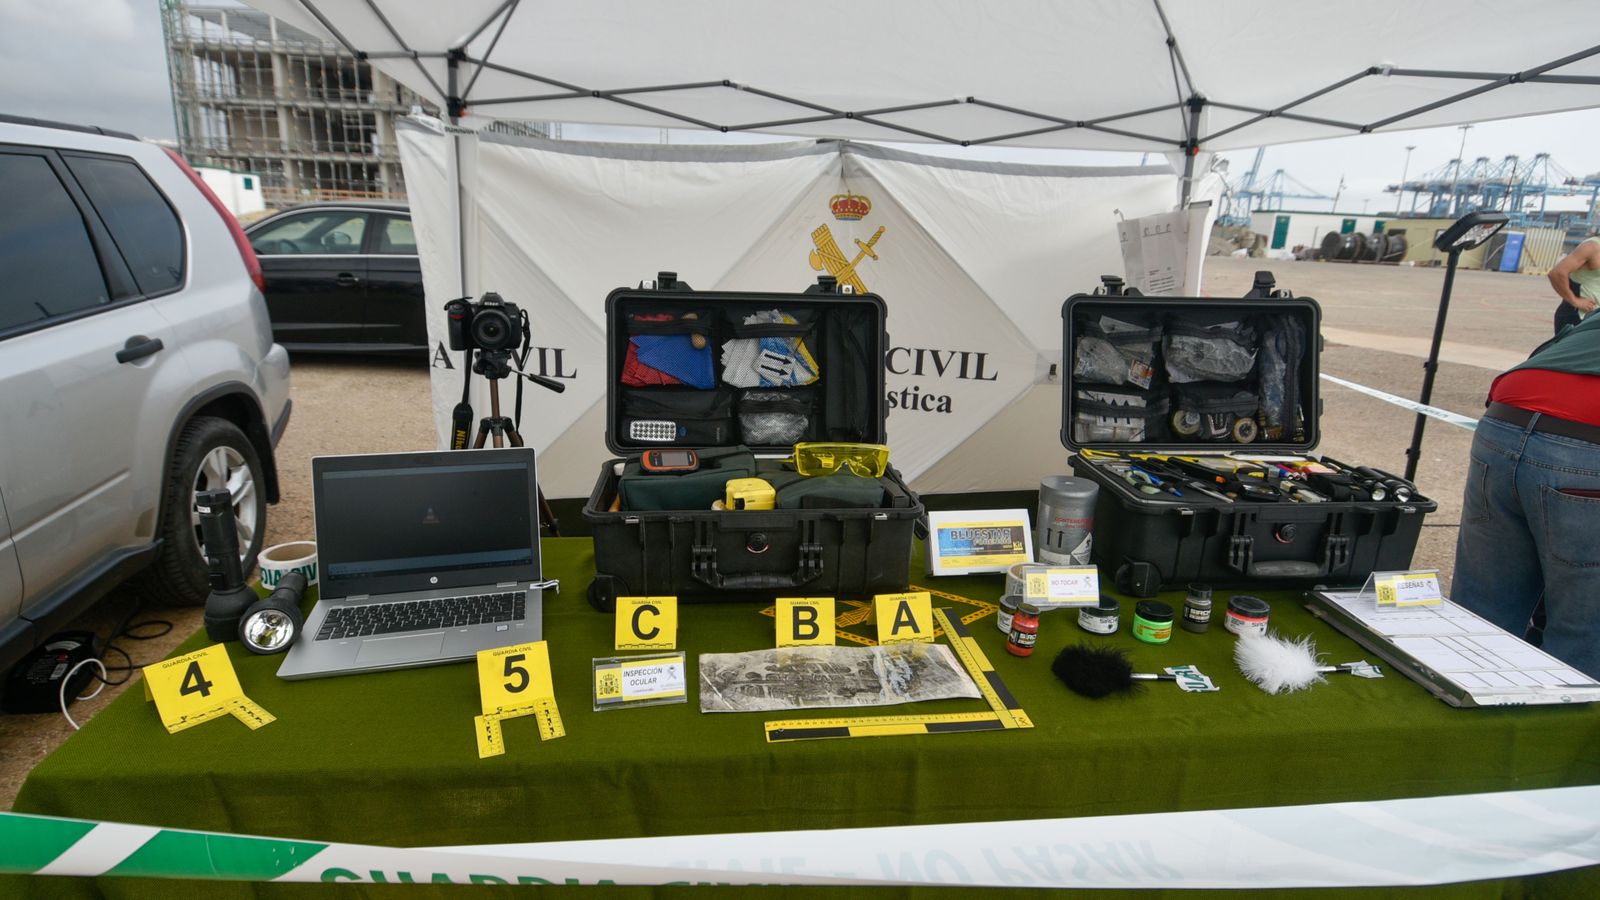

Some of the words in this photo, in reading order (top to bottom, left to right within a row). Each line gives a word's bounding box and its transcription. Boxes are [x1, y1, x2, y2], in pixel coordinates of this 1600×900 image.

[886, 347, 999, 381] CIVIL
[631, 604, 661, 641] C
[792, 605, 820, 641] B
[891, 600, 921, 636] A
[162, 656, 192, 669] GUARDIA
[193, 652, 208, 660] CIVIL
[492, 649, 518, 657] GUARDIA
[180, 661, 213, 697] 4
[504, 653, 530, 693] 5
[623, 667, 663, 678] INSPECCIÓN
[630, 677, 657, 687] OCULAR
